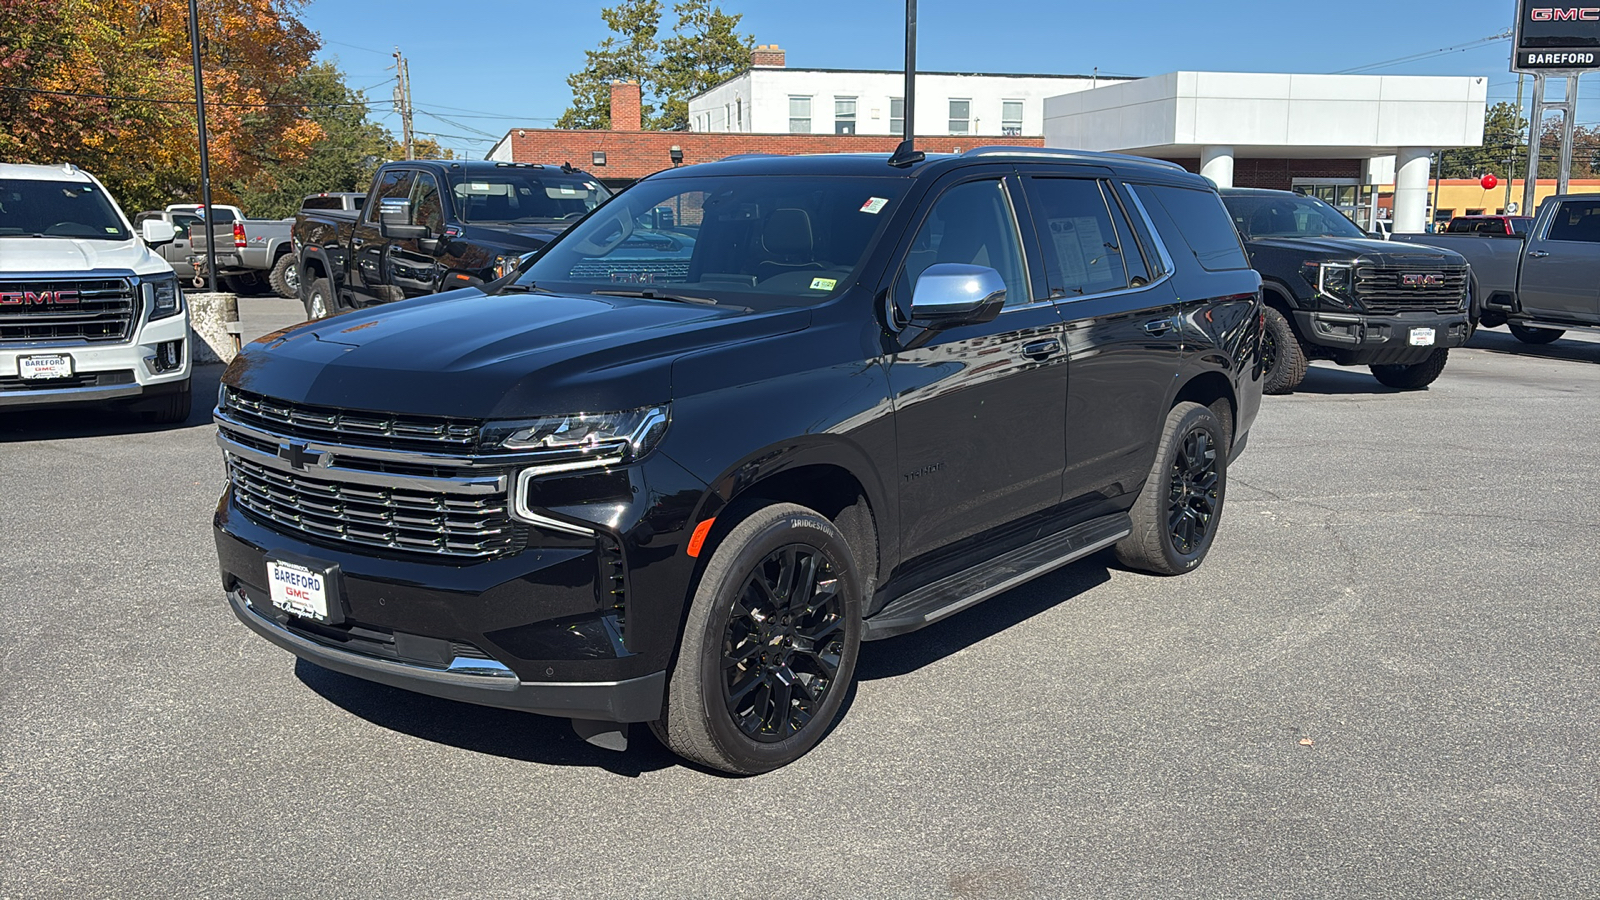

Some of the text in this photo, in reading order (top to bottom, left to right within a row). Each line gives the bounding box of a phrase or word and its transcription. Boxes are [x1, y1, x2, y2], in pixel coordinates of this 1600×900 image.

[1531, 7, 1600, 21] GMC
[1527, 53, 1595, 64] BAREFORD
[1402, 274, 1445, 285] GMC
[0, 290, 80, 305] GMC
[25, 359, 66, 368] BAREFORD
[790, 518, 835, 539] BRIDGESTONE
[274, 568, 321, 591] BAREFORD
[286, 586, 310, 601] GMC
